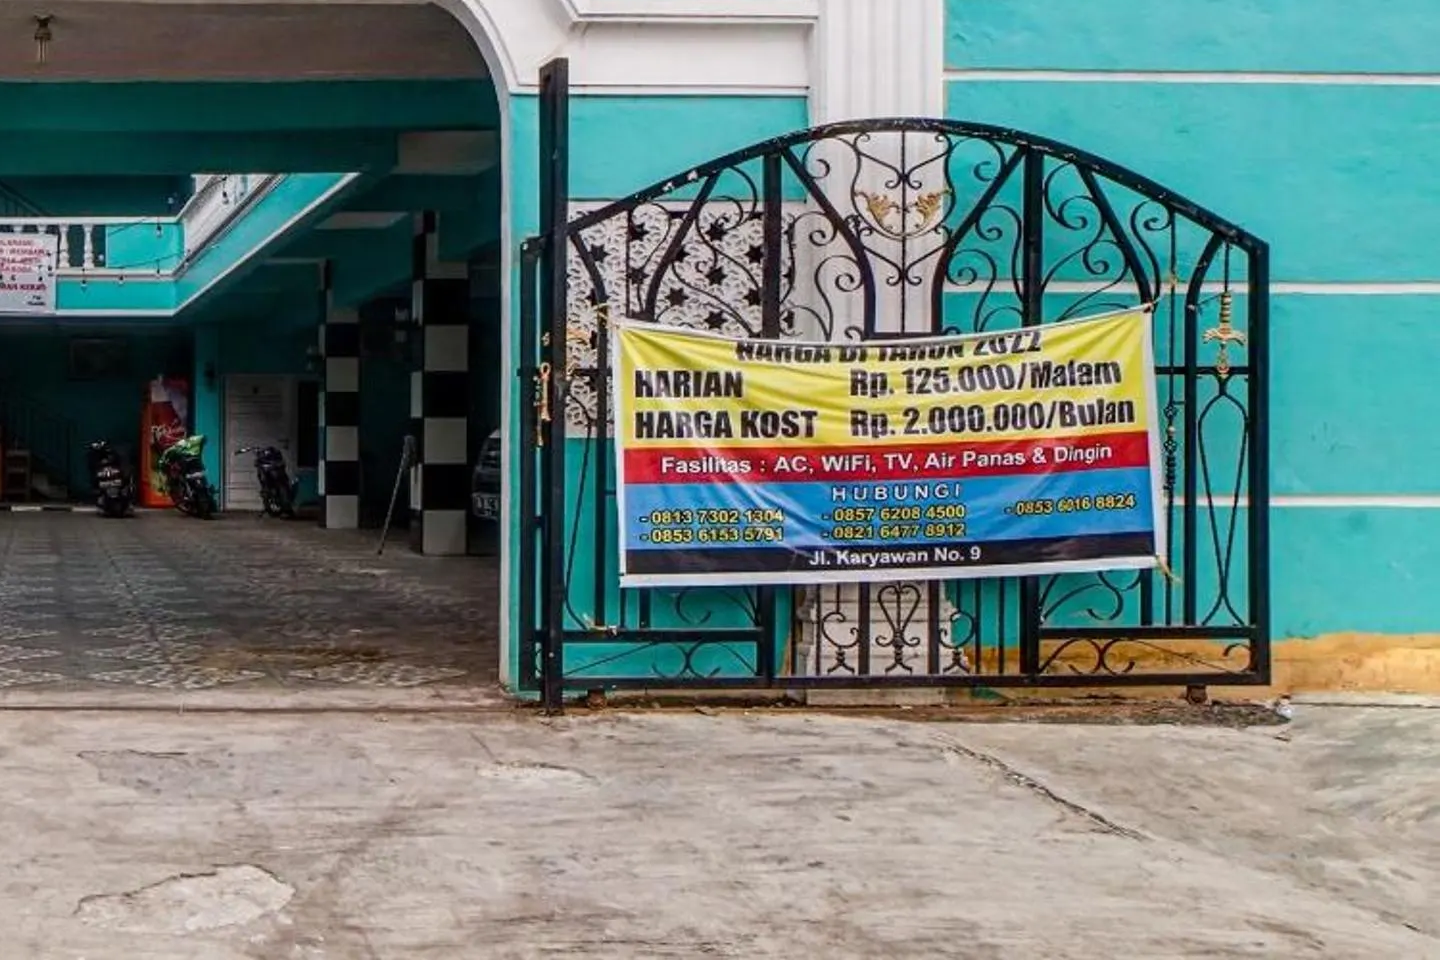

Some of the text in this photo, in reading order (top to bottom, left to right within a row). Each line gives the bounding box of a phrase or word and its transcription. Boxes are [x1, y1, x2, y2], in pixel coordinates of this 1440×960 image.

[635, 370, 743, 398] HARIAN
[849, 368, 895, 398] Rp.
[635, 398, 1135, 439] HARGA KOST Rp. 2.000.000/Bulan
[661, 456, 751, 474] Fasilitas
[774, 456, 814, 475] AC,
[822, 454, 877, 473] WiFi,
[884, 453, 918, 472] TV,
[924, 452, 955, 469] Air
[962, 449, 1025, 467] Panas
[1032, 449, 1046, 464] &
[1054, 445, 1112, 465] Dingin
[832, 483, 960, 501] HUBUNGI
[698, 509, 739, 524] 7302
[744, 508, 783, 523] 1304
[834, 507, 875, 521] 0857
[880, 506, 921, 521] 6208
[925, 505, 965, 520] 4500
[1016, 500, 1053, 515] 0853
[651, 528, 693, 543] 0853
[698, 528, 739, 542] 6153
[744, 527, 783, 542] 5791
[834, 526, 874, 539] 0821
[880, 525, 920, 538] 6477
[925, 523, 965, 537] 8912
[809, 545, 981, 568] Jl. Karyawan No. 9
